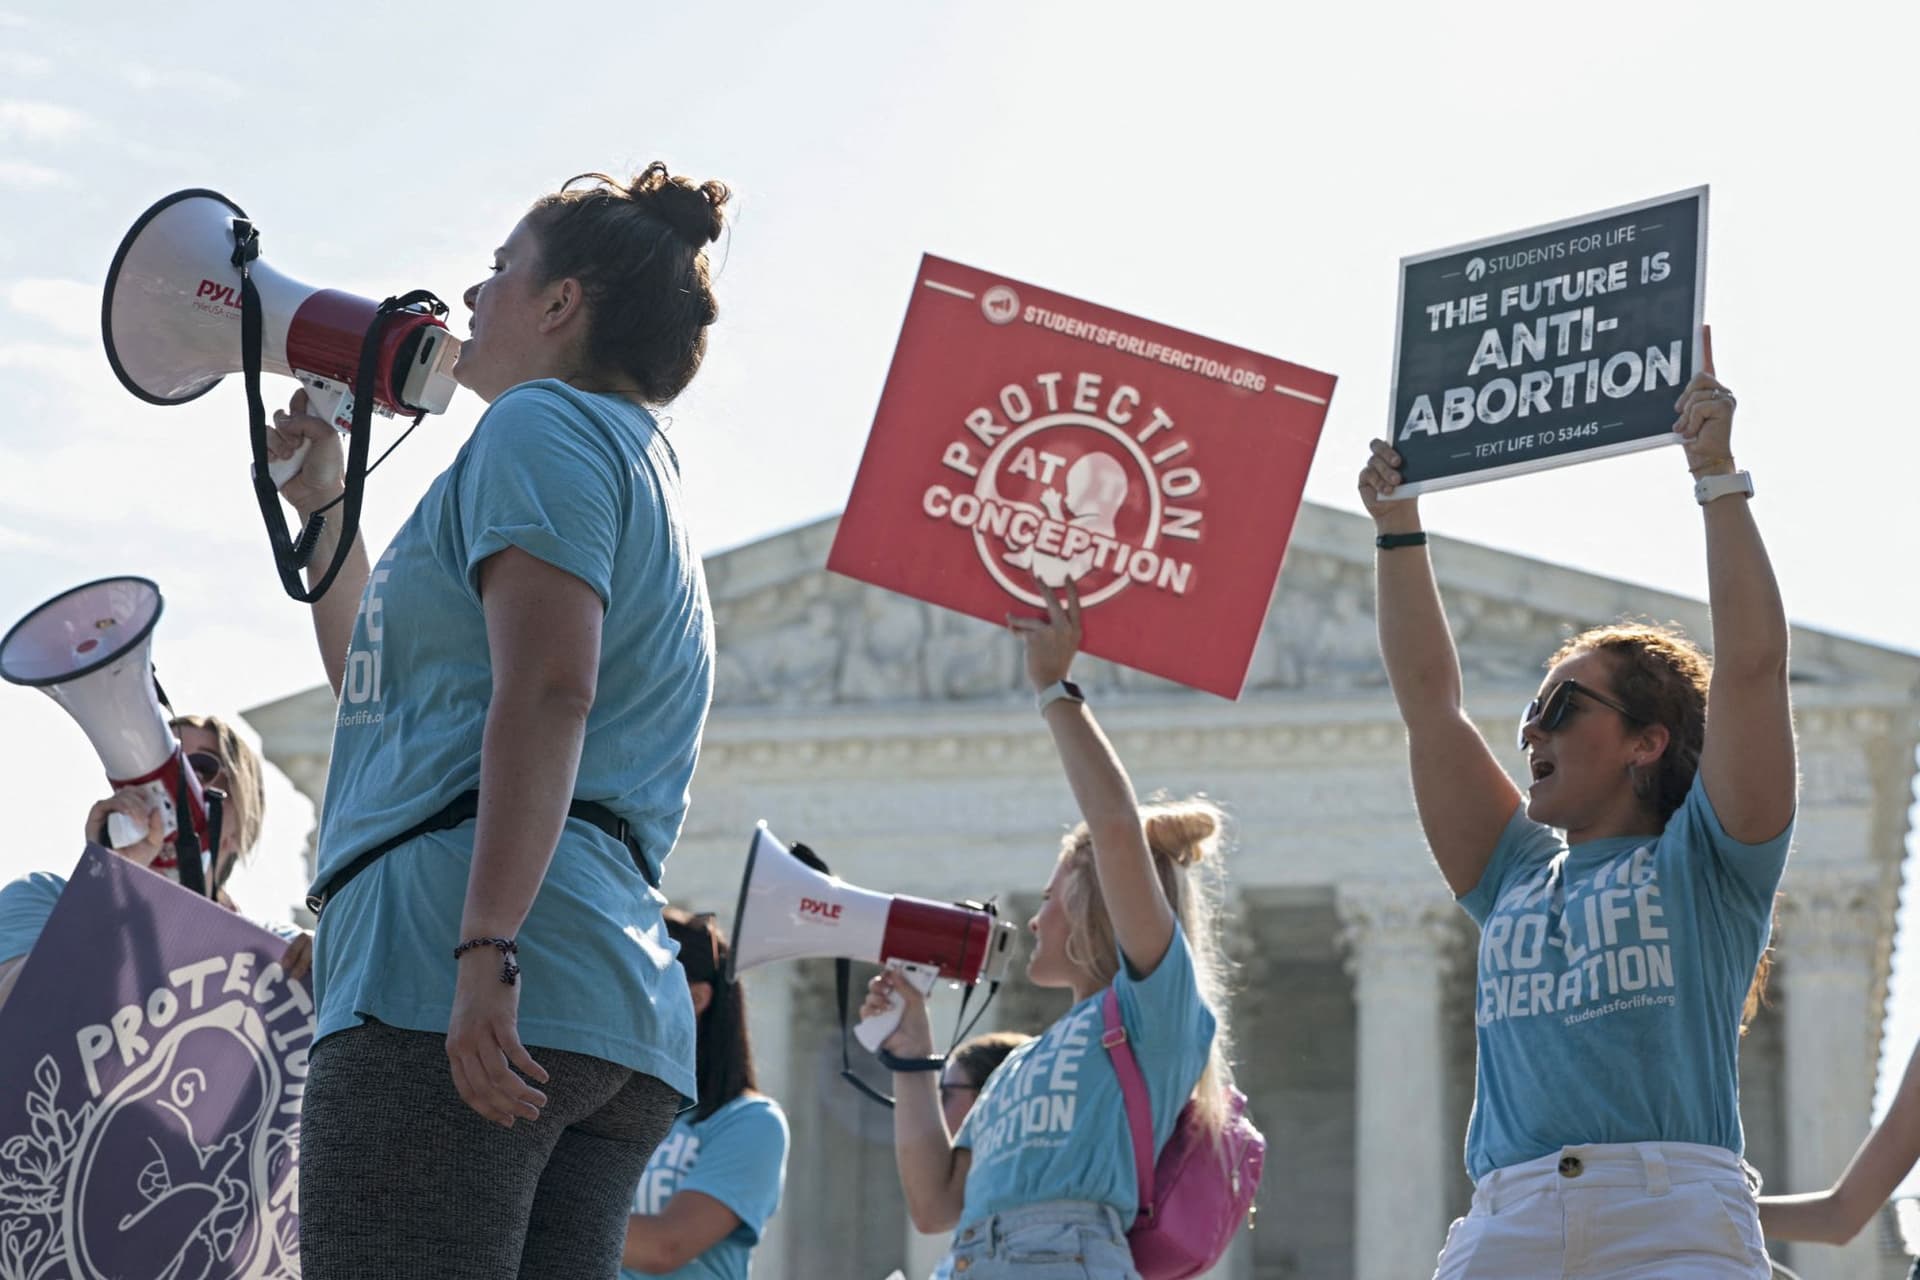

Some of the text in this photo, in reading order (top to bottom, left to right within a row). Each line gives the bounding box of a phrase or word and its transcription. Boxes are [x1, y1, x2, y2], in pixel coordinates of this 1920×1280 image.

[1489, 225, 1636, 274] STUDENTS FOR LIFE
[1426, 251, 1671, 332] THE FUTURE IS
[1024, 305, 1266, 392] STUDENTSFORLIFEACTION.ORG
[1467, 305, 1618, 376] ANTI-
[1398, 340, 1682, 441] ABORTION
[943, 372, 1202, 540] PROTECTION
[1008, 447, 1066, 485] AT
[1475, 422, 1599, 458] TEXT LIFE TO 53445
[922, 484, 1192, 594] CONCEPTION
[800, 897, 843, 919] PYLE
[1484, 884, 1669, 973] RO-LIFE
[1477, 944, 1675, 1028] ENERATION
[1564, 994, 1676, 1026] studentsforlife.org
